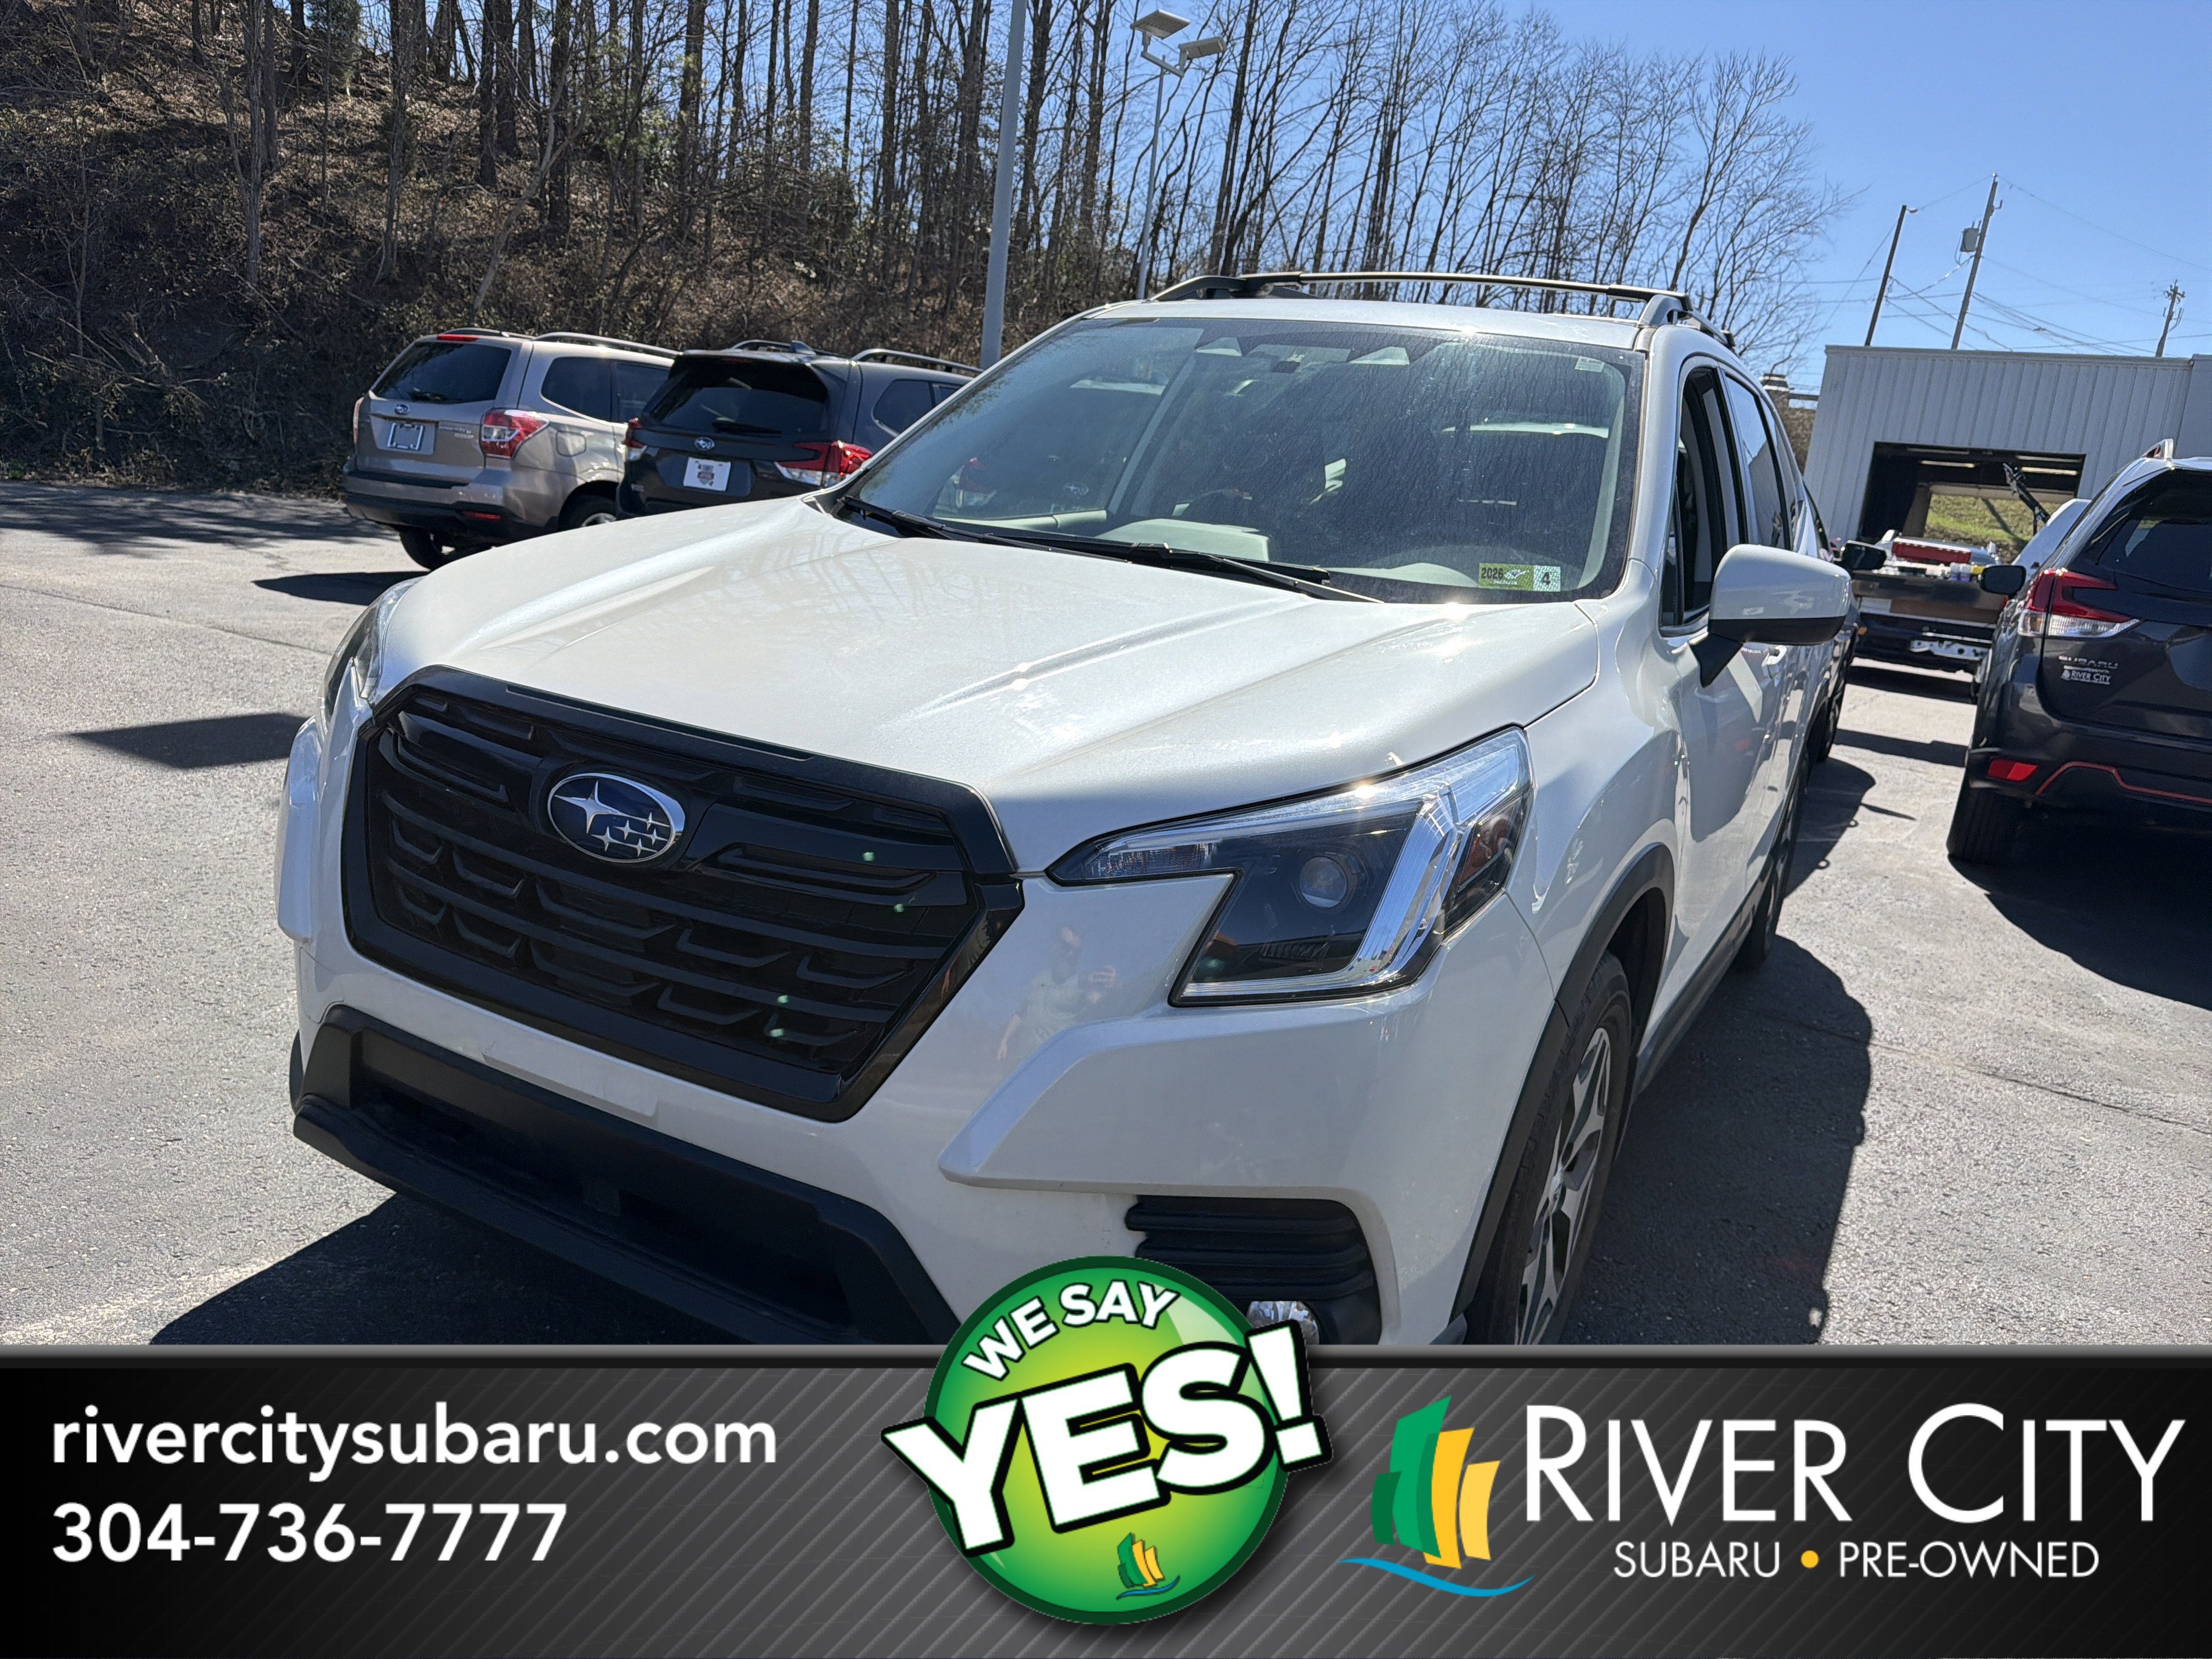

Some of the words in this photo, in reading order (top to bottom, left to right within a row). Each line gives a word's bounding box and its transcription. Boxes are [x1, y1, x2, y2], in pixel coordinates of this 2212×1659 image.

[1481, 567, 1503, 579] 2026
[1542, 572, 1551, 585] 4
[2072, 670, 2091, 679] RIVER
[2093, 673, 2111, 682] CITY
